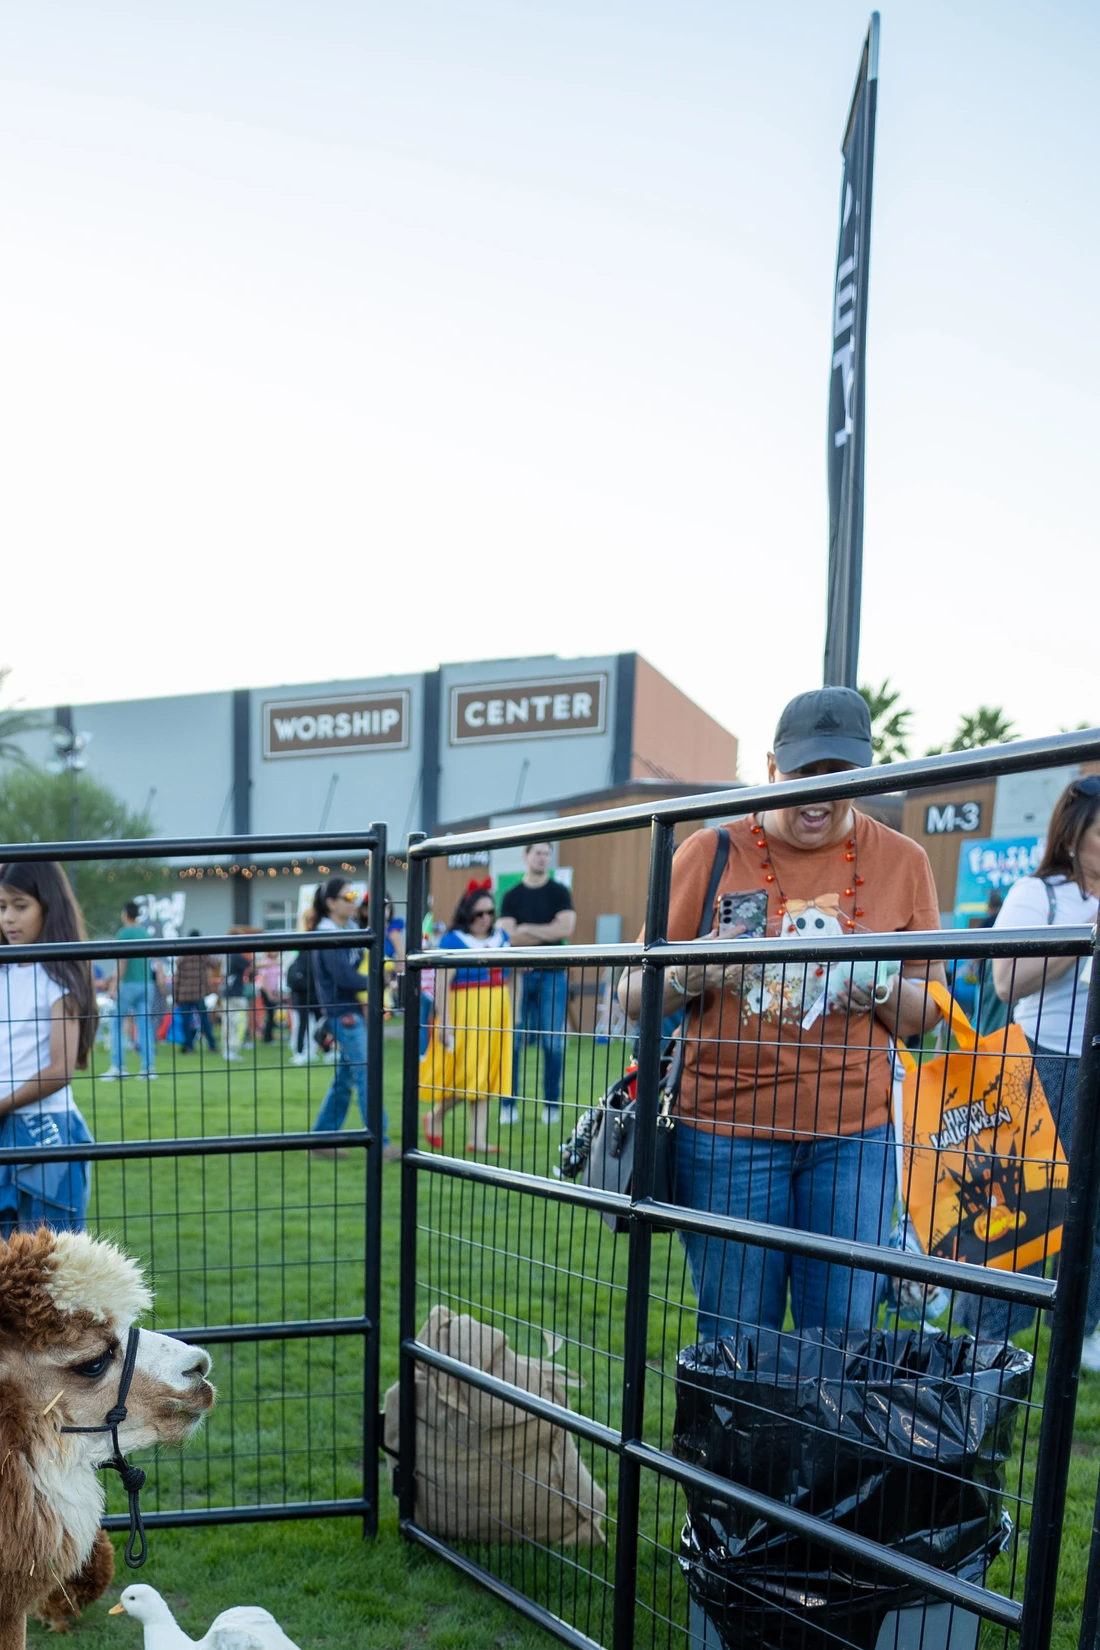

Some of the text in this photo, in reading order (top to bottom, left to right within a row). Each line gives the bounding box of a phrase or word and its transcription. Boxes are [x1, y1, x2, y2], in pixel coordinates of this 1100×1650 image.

[273, 708, 400, 742] WORSHIP
[464, 692, 592, 728] CENTER
[927, 802, 980, 833] M-3
[929, 1106, 1013, 1149] HALLOWEEN
[942, 1099, 986, 1131] HAPPY
